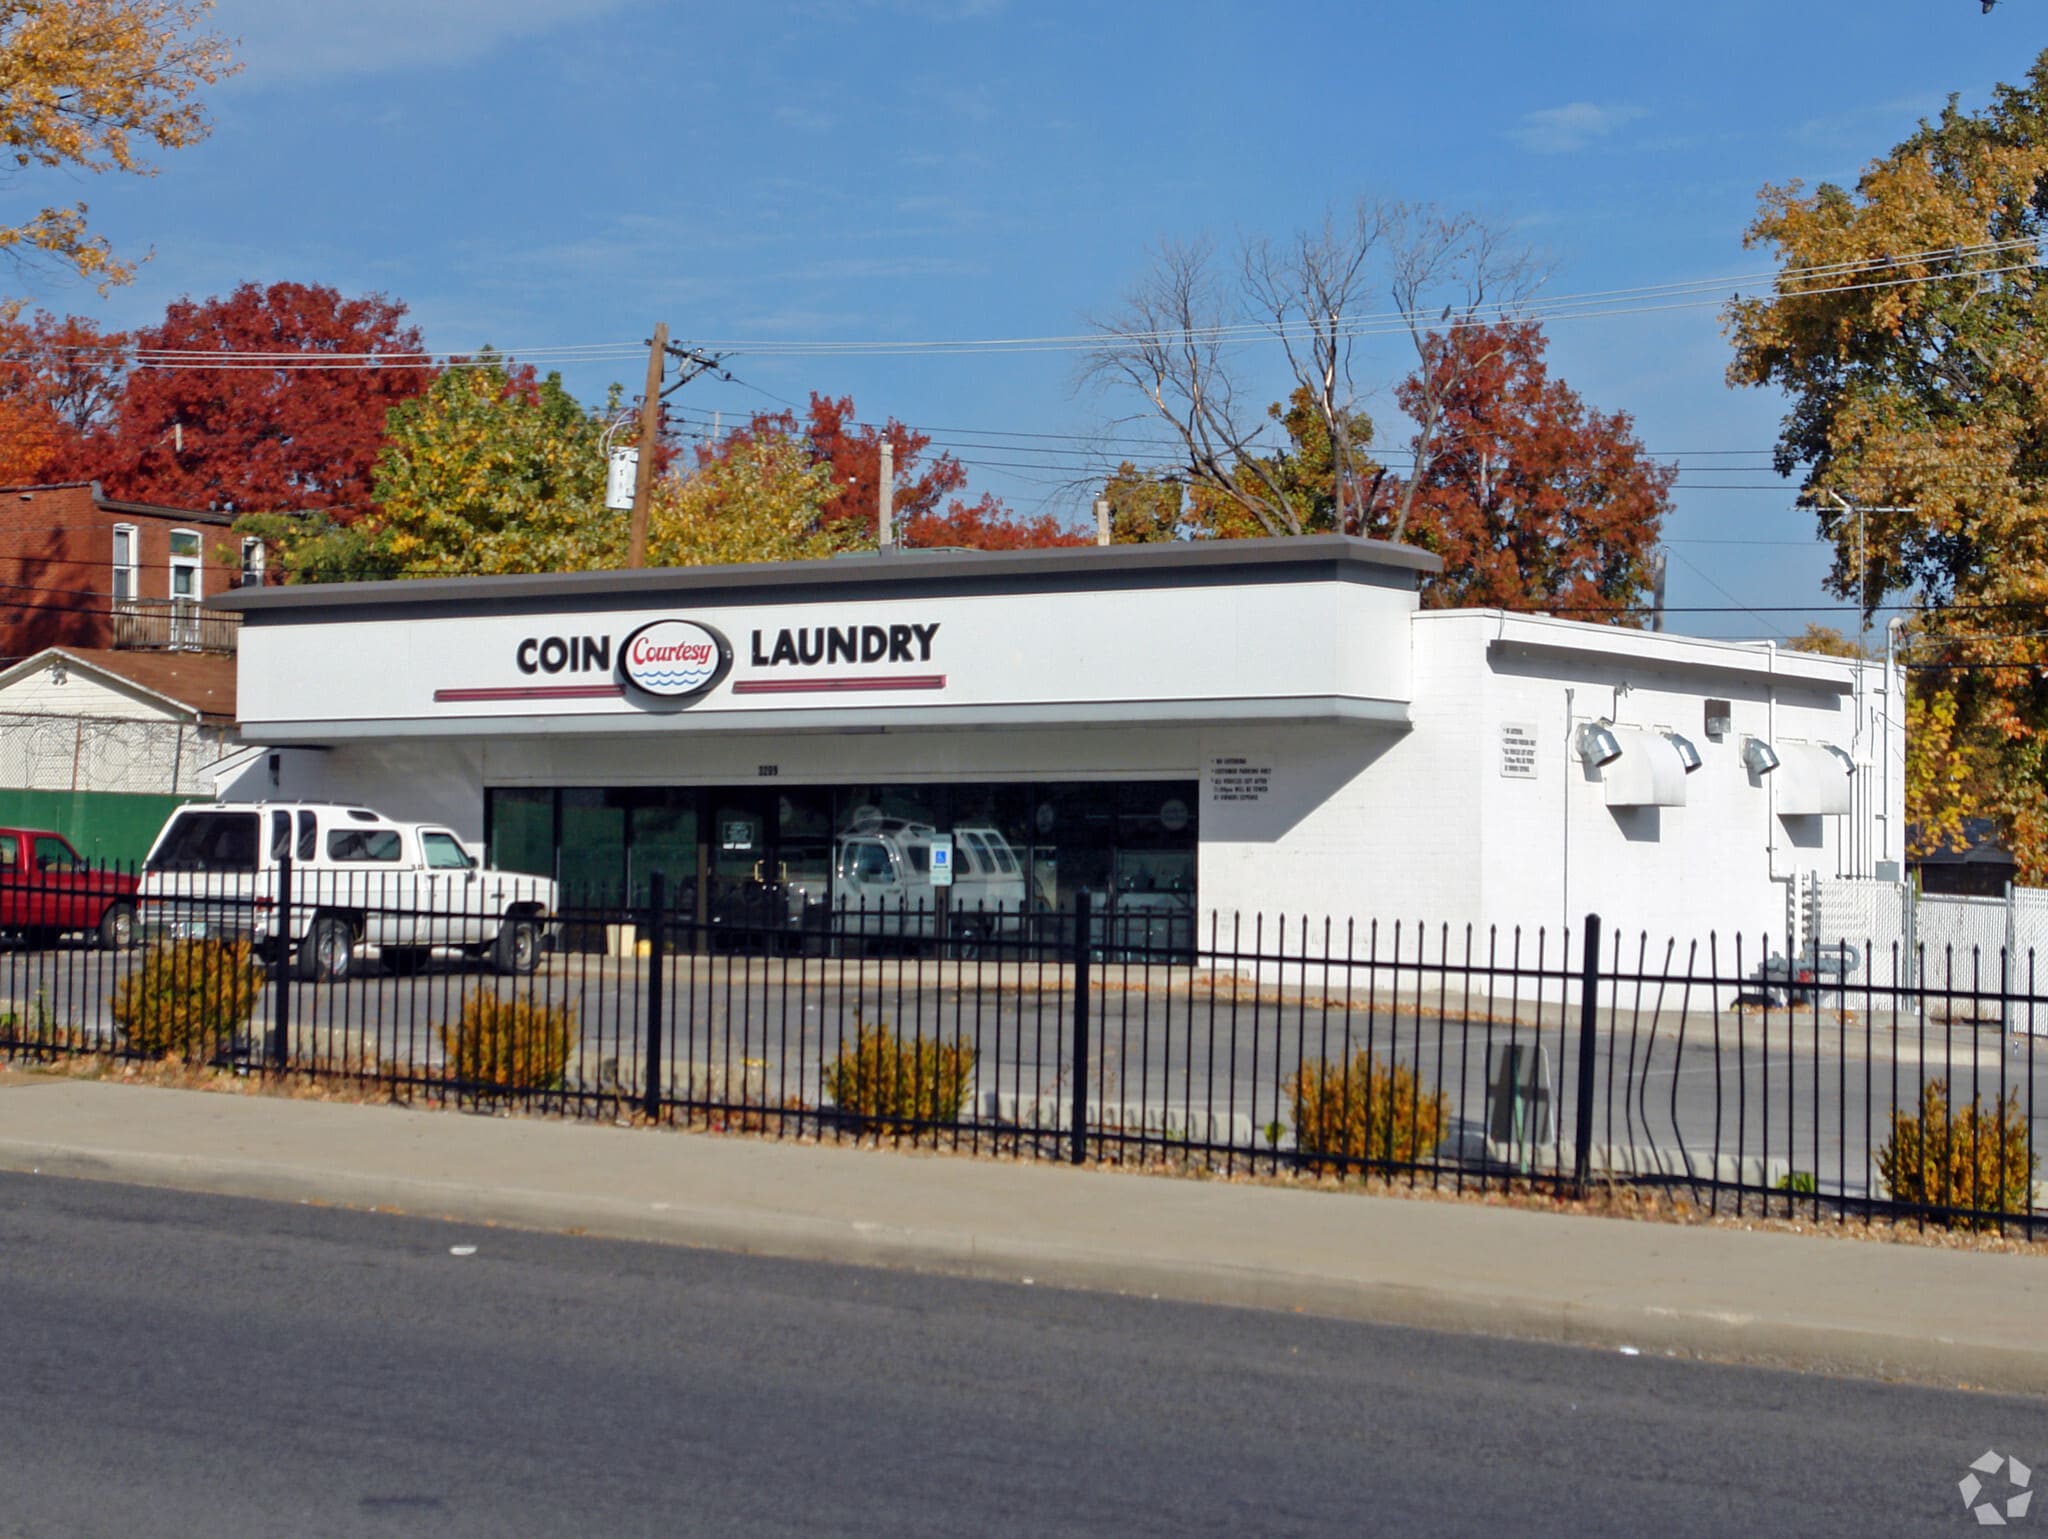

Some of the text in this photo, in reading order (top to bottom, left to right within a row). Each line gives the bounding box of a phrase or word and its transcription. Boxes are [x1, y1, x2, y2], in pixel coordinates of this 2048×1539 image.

[516, 622, 941, 675] COIN LAUNDRY
[632, 636, 713, 666] Courtesy
